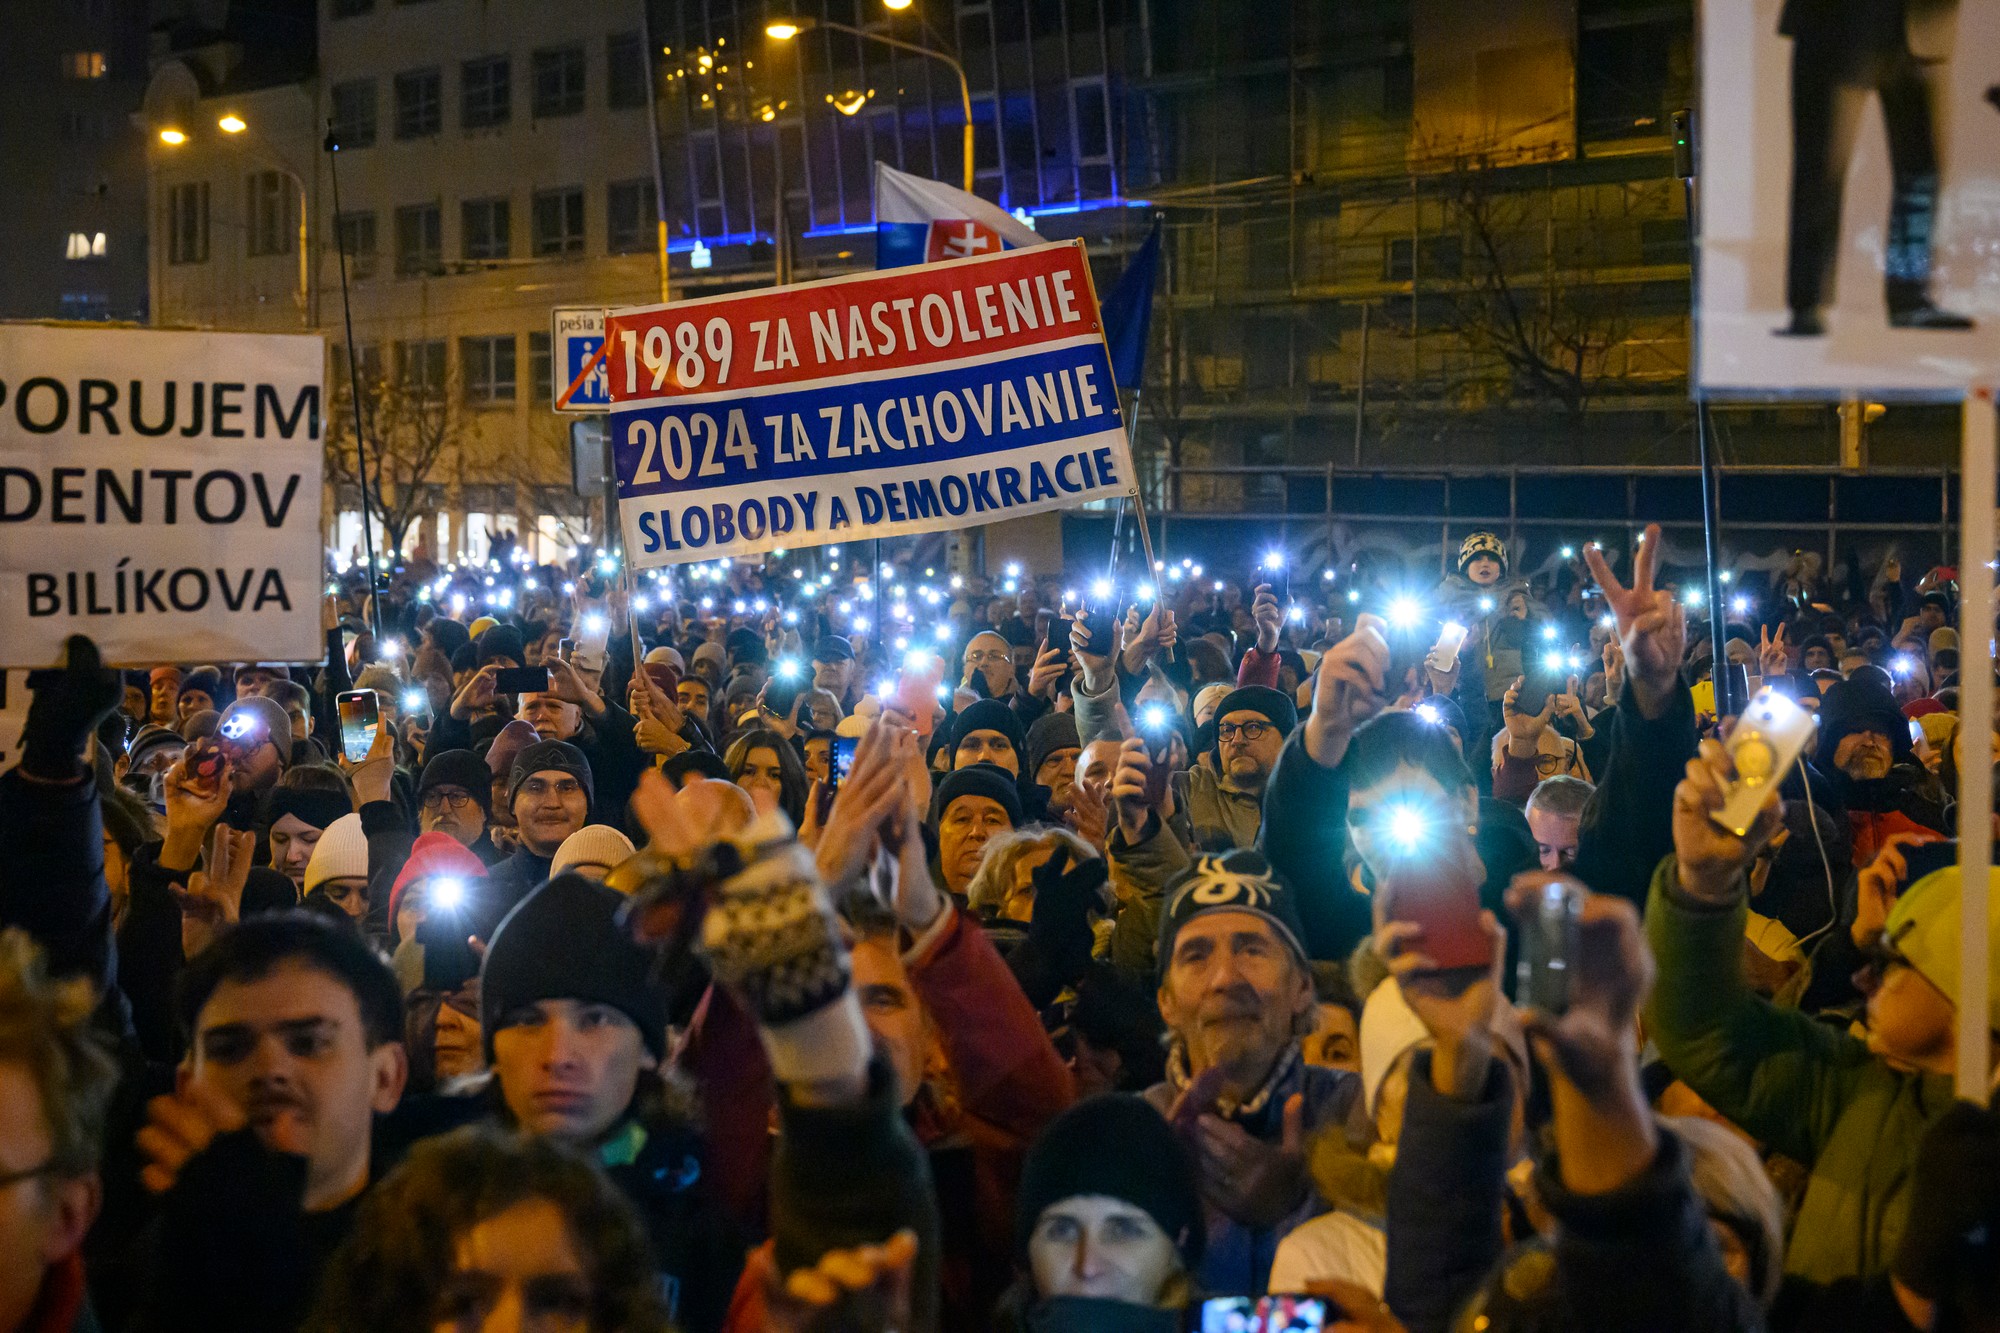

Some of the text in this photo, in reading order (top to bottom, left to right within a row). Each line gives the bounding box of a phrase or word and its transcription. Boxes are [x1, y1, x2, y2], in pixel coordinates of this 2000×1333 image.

[560, 315, 595, 333] pešia
[620, 269, 1081, 394] 1989 ZA NASTOLENIE
[627, 364, 1104, 486] 2024 ZA ZACHOVANIE
[638, 447, 1119, 554] SLOBODY A DEMOKRACIE
[26, 557, 292, 618] BILÍKOVA
